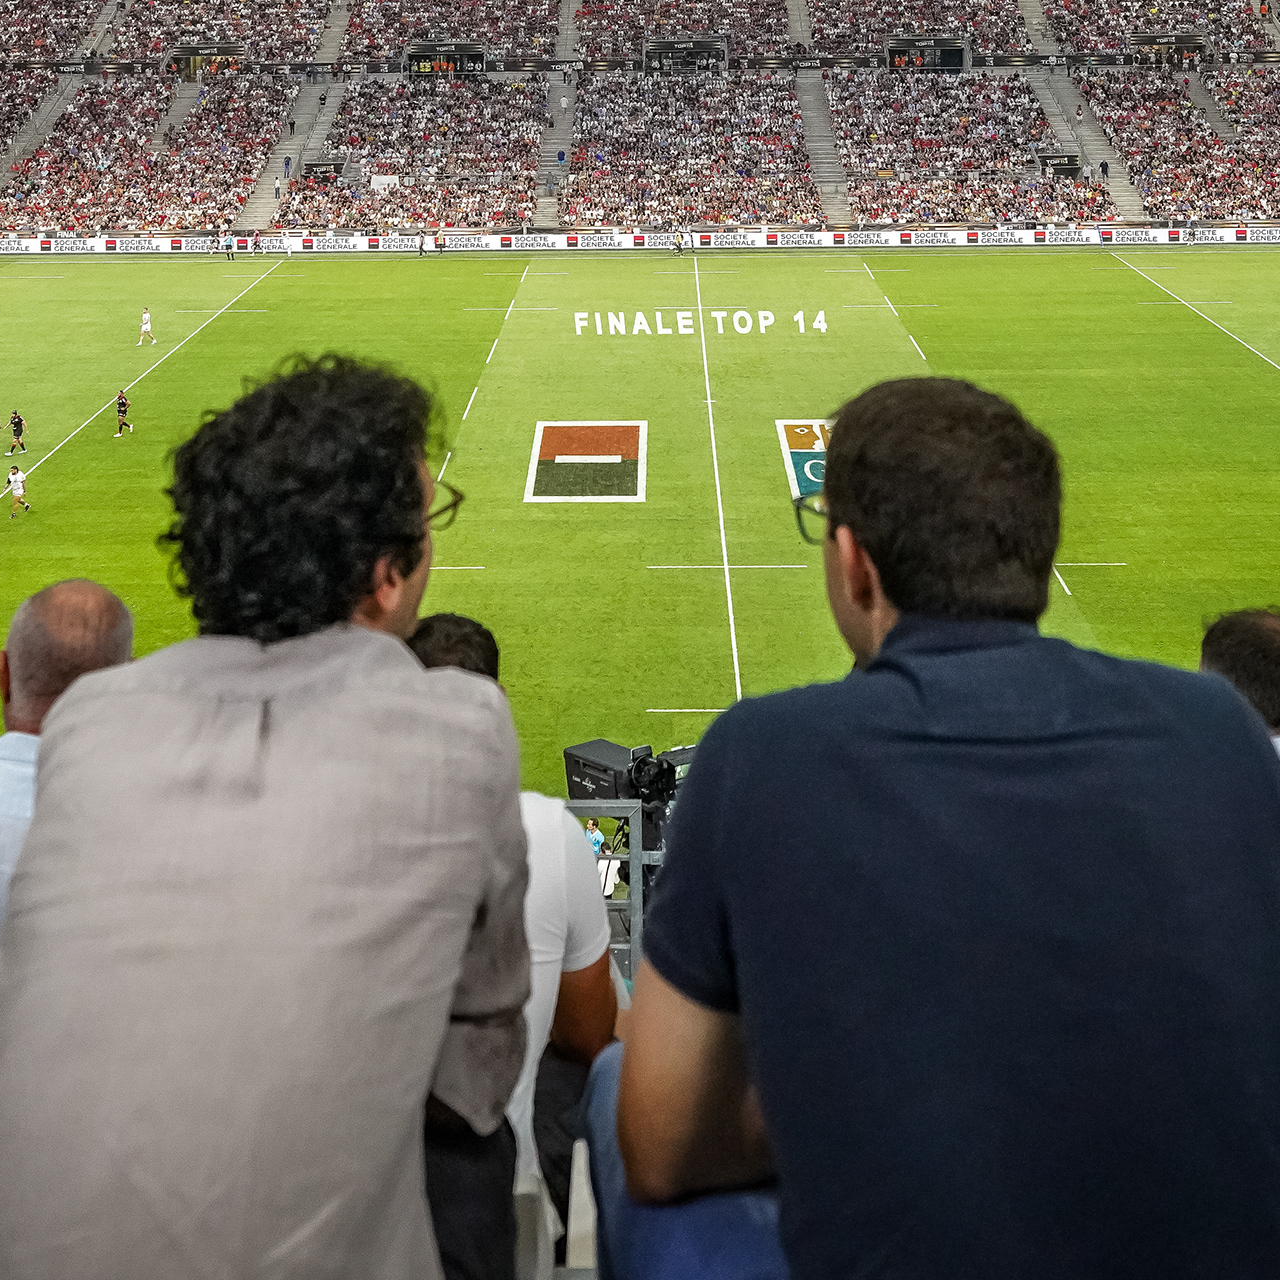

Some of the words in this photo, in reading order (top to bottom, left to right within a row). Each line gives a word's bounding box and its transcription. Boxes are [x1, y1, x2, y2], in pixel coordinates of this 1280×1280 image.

[574, 310, 695, 336] FINALE
[710, 310, 776, 334] TOP
[793, 310, 828, 334] 14
